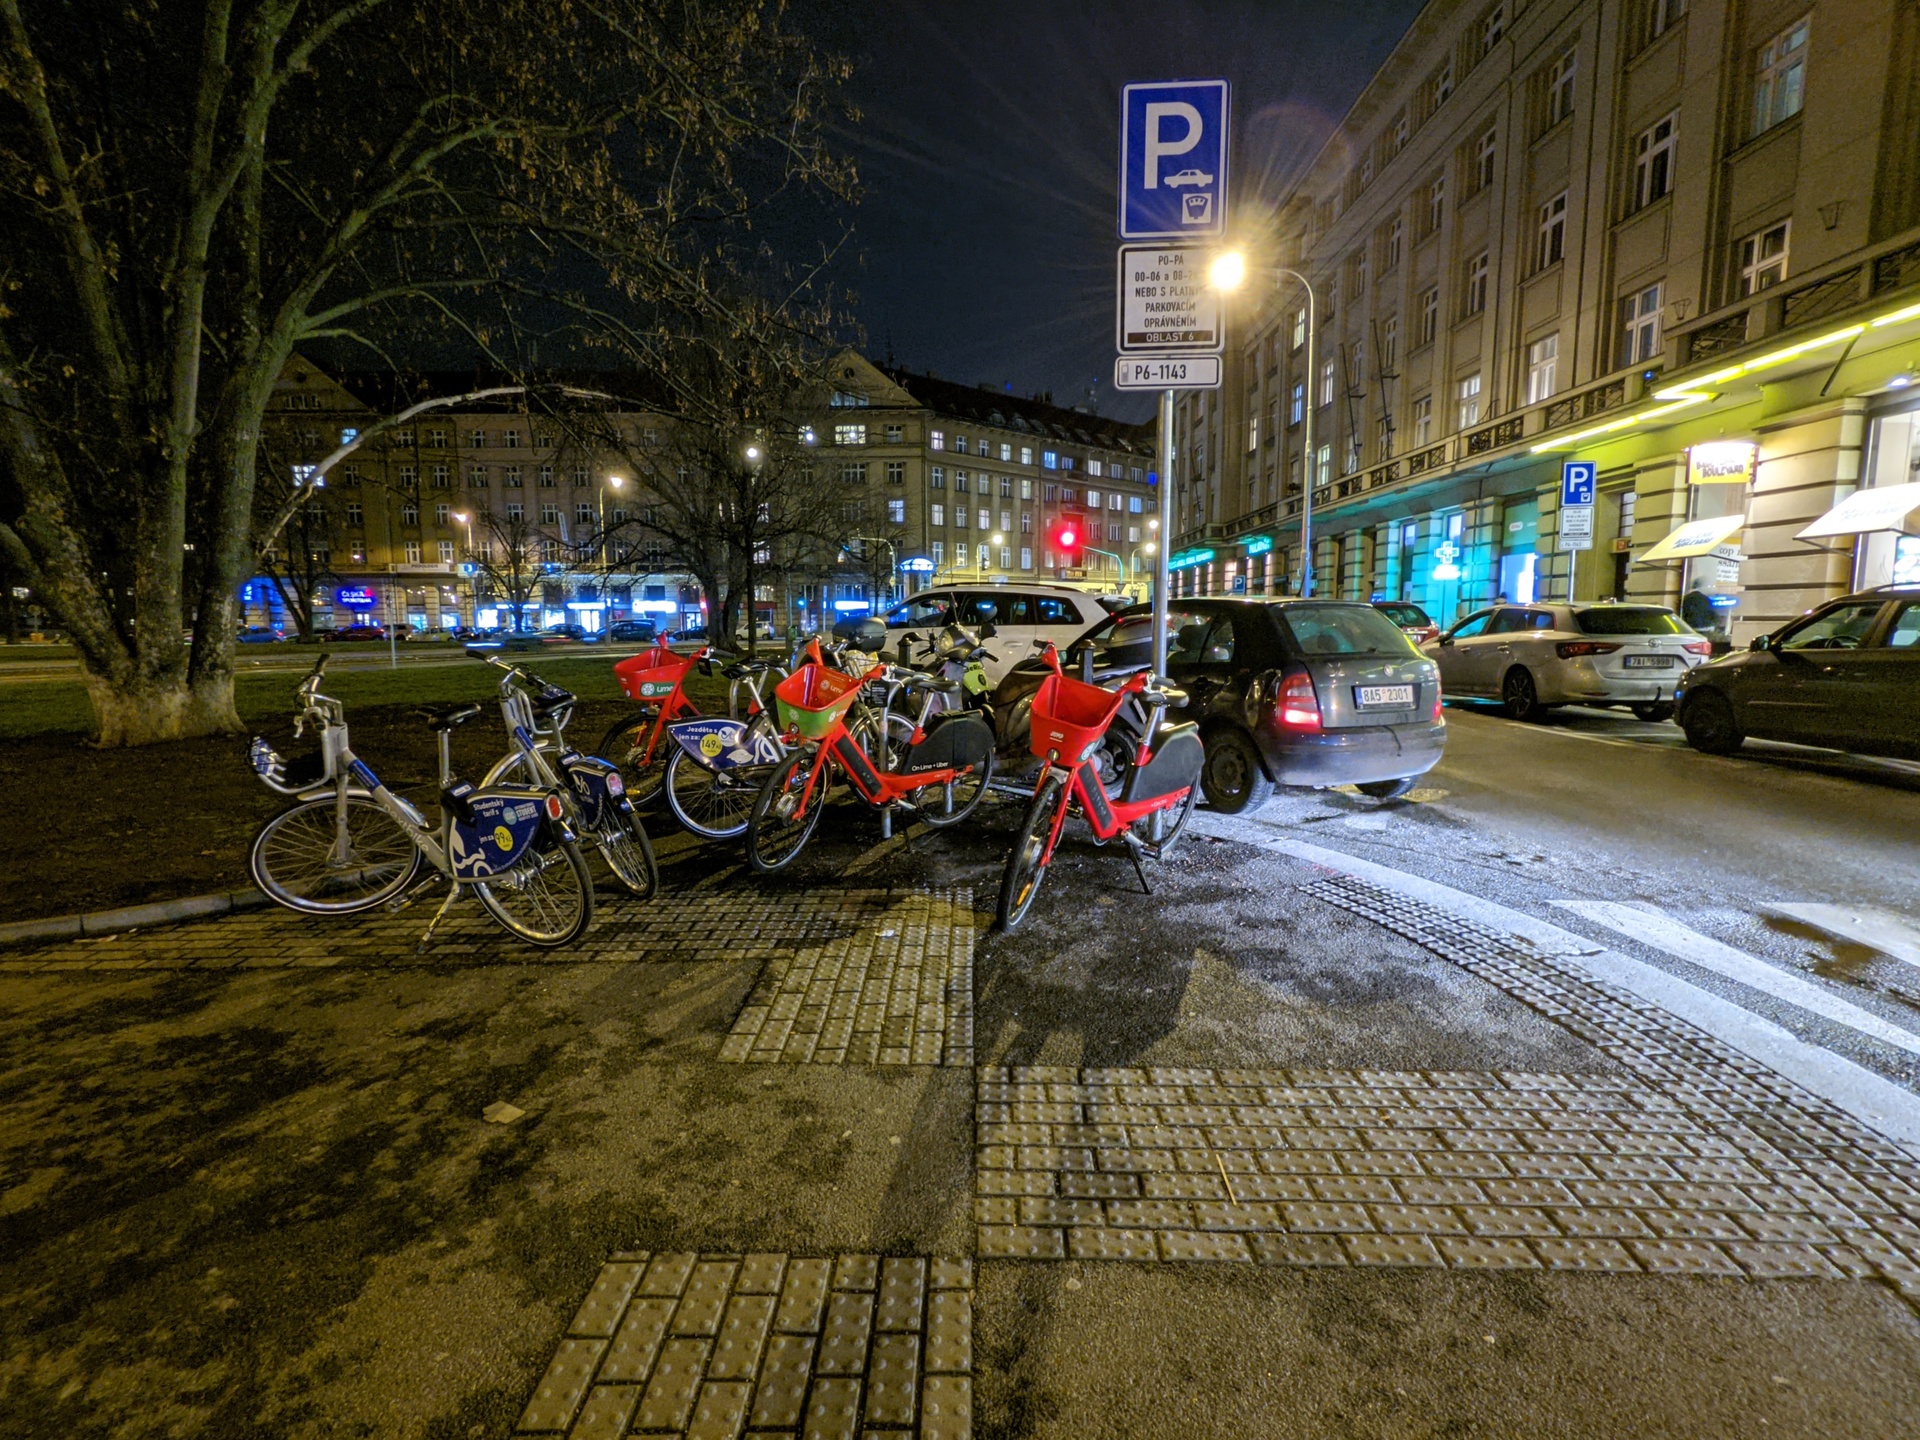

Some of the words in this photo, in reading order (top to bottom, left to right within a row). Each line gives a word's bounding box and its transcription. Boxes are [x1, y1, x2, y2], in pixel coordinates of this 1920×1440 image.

[1144, 102, 1203, 189] P
[1158, 254, 1184, 266] PO-PÁ
[1134, 271, 1161, 282] 00-06
[1135, 286, 1157, 298] NEBO
[1160, 286, 1166, 297] S
[1145, 300, 1196, 313] PARKOVACÍM
[1144, 315, 1197, 328] OPRÁVNĚNÍM
[1146, 332, 1184, 342] OBLAST
[1188, 331, 1194, 341] 6
[1135, 364, 1187, 380] P6-1143
[1569, 466, 1589, 493] P
[1234, 577, 1243, 589] P
[1363, 688, 1381, 702] 8A5
[1387, 688, 1409, 701] 2301
[686, 726, 713, 734] Jezděte
[701, 739, 717, 749] 149
[473, 799, 504, 811] Studentský
[515, 805, 537, 818] STUDENT
